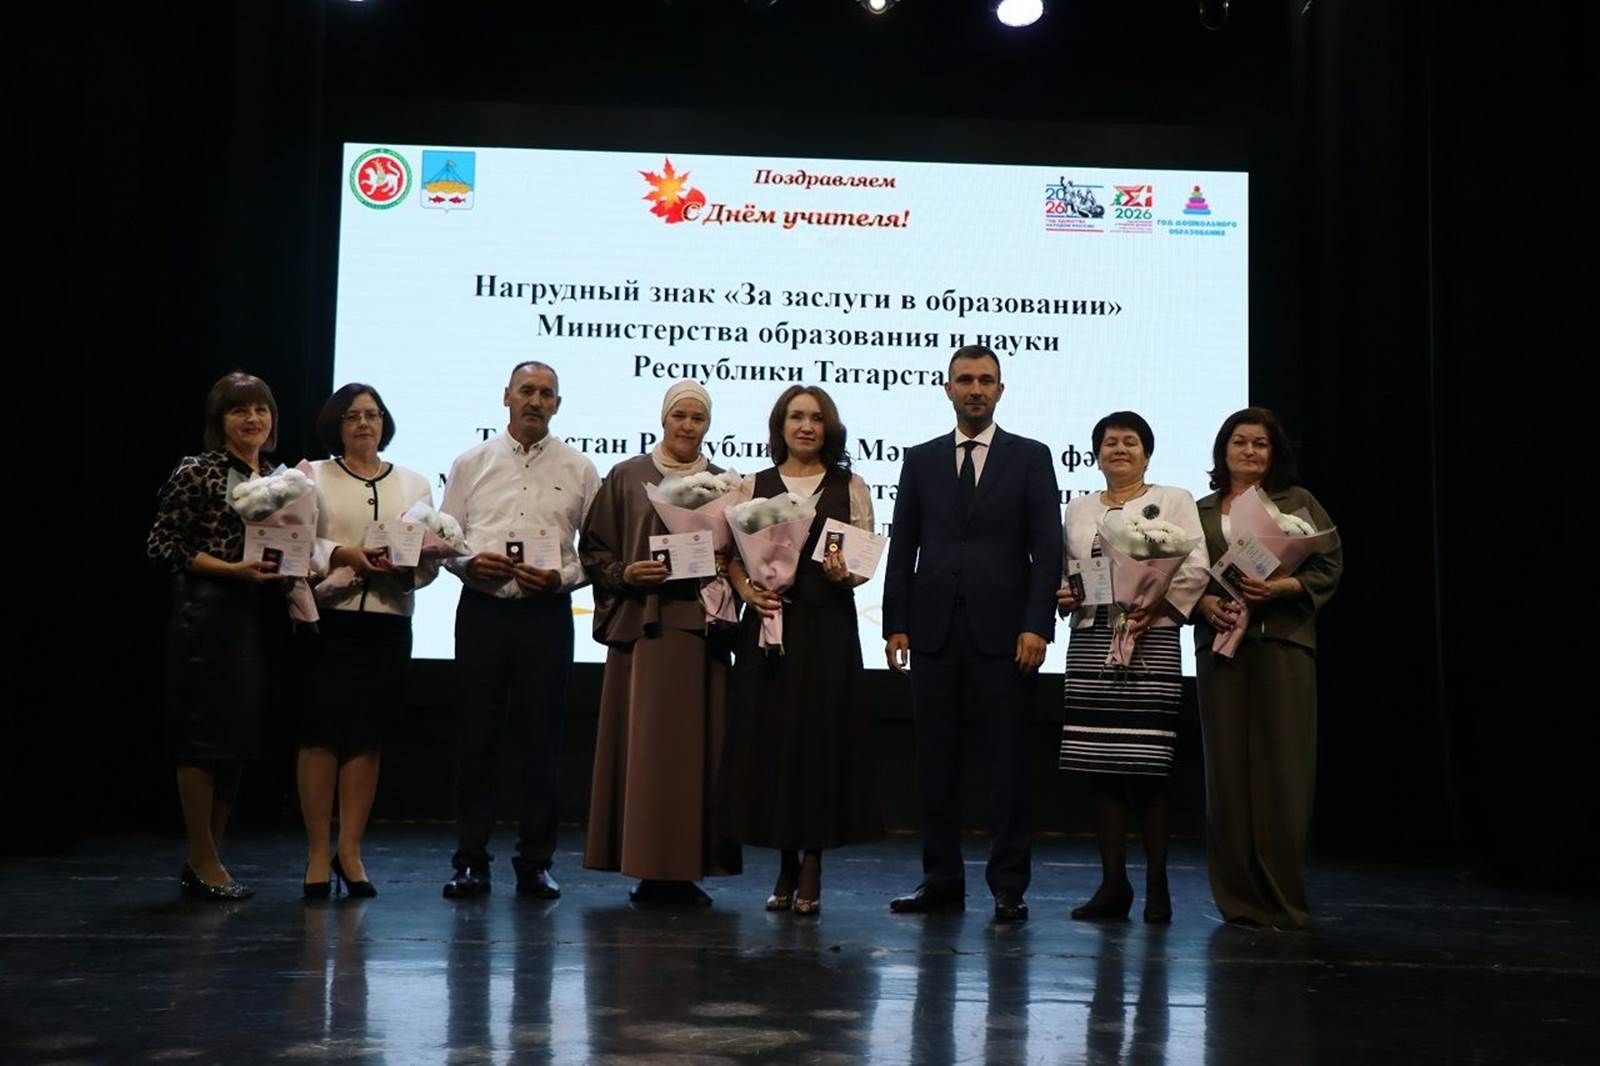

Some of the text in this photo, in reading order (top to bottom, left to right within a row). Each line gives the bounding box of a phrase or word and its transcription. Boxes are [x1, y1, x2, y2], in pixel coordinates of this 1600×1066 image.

[754, 168, 896, 190] Поздравляем
[683, 203, 910, 230] С Днём учителя!
[1114, 208, 1153, 220] 2026
[475, 273, 1122, 317] Нагрудный знак «За заслуги в образовании»
[537, 313, 1059, 357] Министерства образования и науки
[633, 354, 945, 391] Республики Татарста
